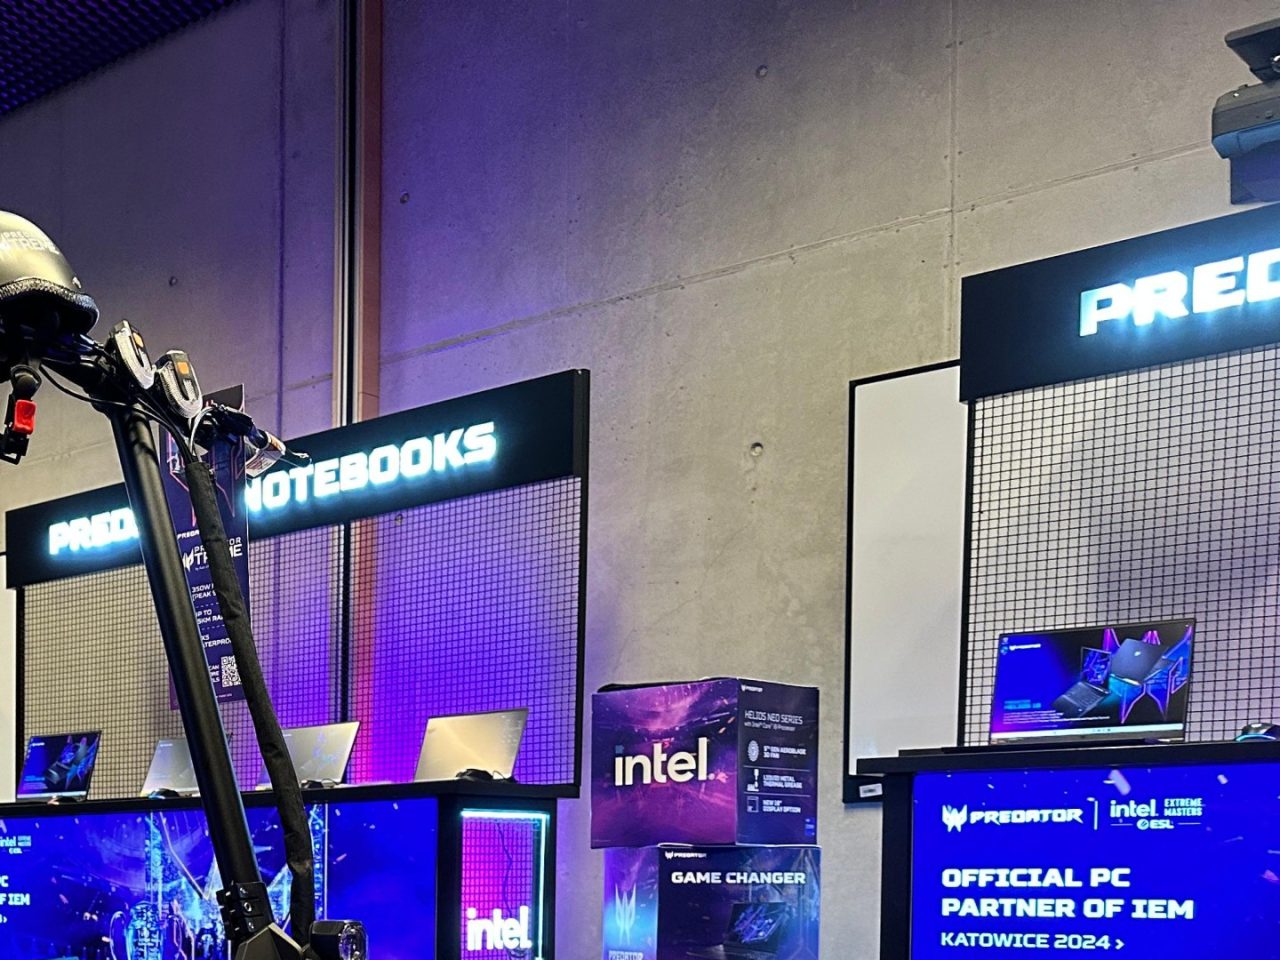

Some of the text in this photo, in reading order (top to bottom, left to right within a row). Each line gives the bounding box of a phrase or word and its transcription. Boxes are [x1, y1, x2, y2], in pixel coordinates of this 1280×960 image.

[48, 507, 139, 555] PRED
[744, 709, 804, 725] HELIOS NEO SERIES
[1164, 798, 1204, 808] EXTREME
[969, 806, 1084, 826] PREDATOR
[1164, 807, 1204, 817] MASTERS
[1149, 819, 1175, 830] ESL
[671, 871, 806, 884] GAME CHANGER
[941, 867, 1131, 888] OFFICIAL PC
[8, 893, 31, 906] IEM
[941, 898, 1195, 920] PARTNER OF IEM
[940, 931, 1111, 951] KATOWICE 2024
